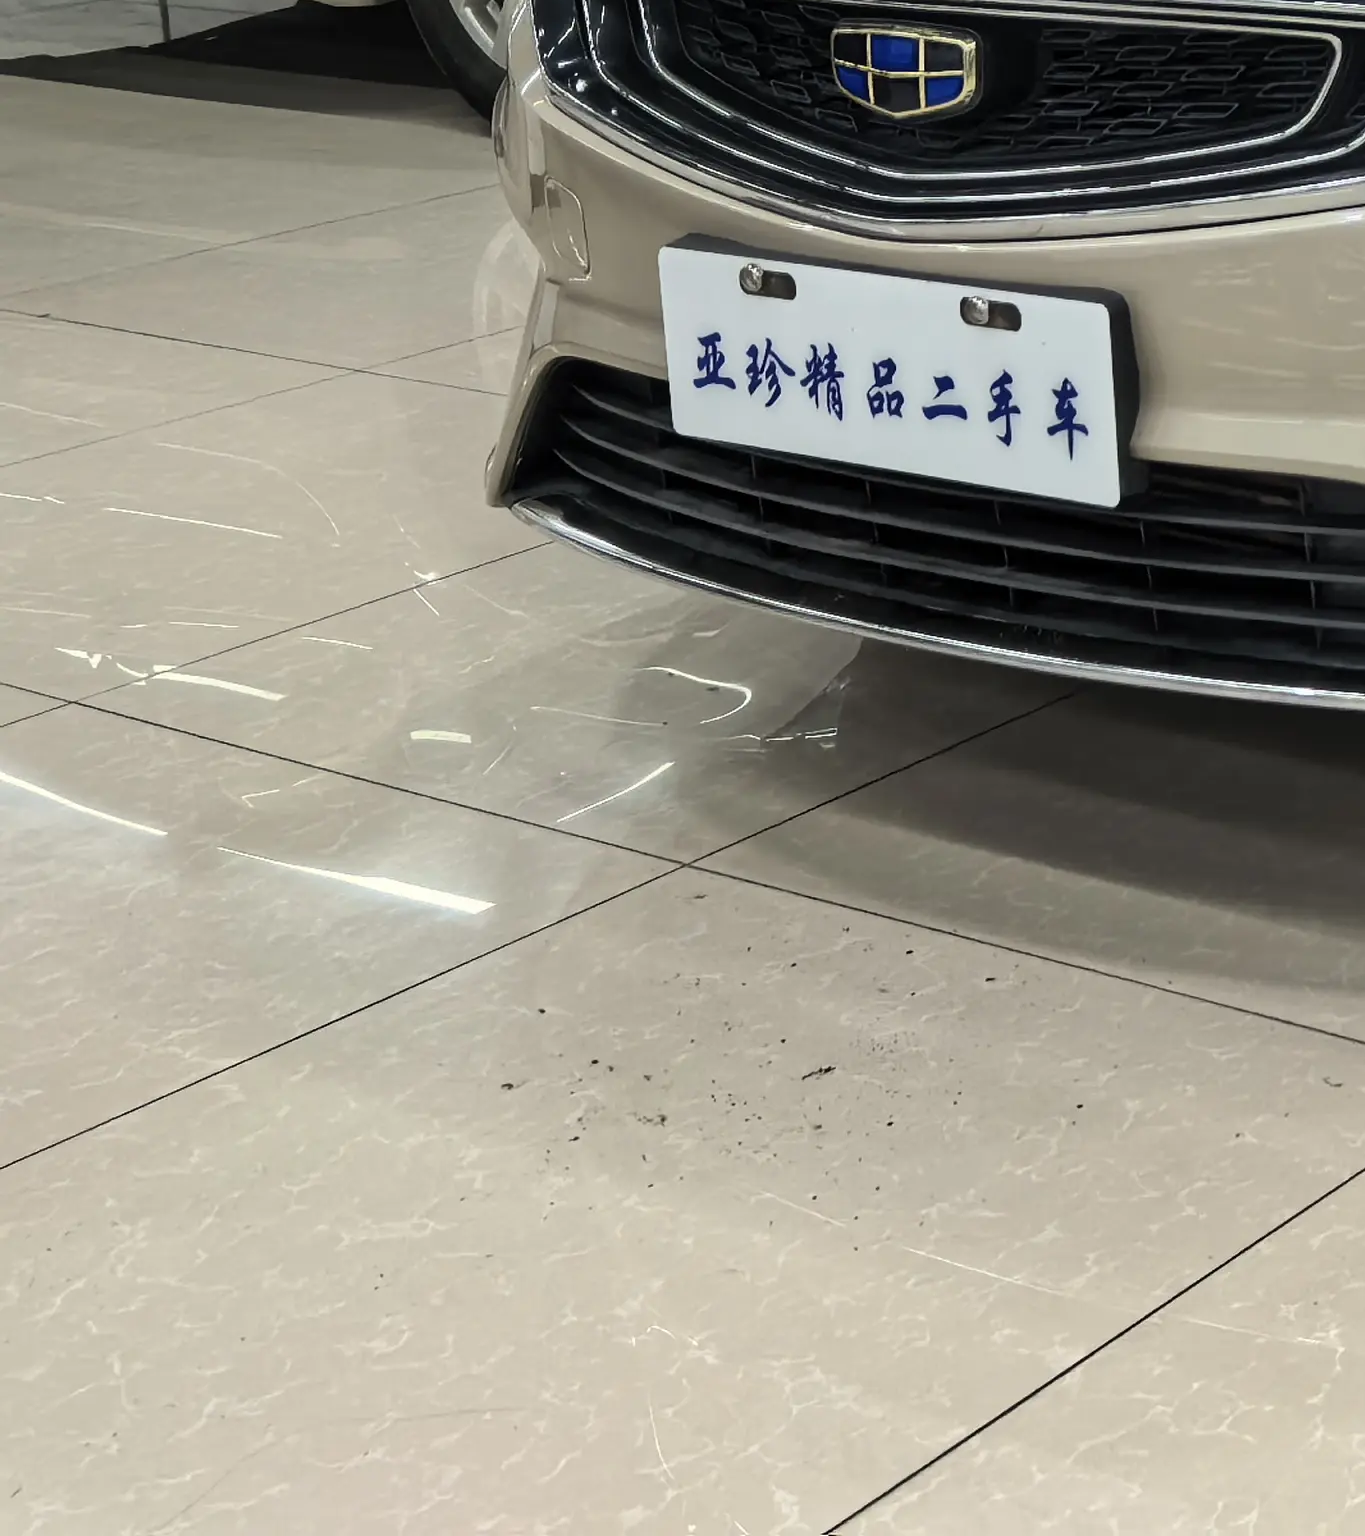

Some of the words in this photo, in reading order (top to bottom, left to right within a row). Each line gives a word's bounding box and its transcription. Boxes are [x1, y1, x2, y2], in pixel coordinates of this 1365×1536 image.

[693, 331, 1089, 461] 亚珍精品二手车
